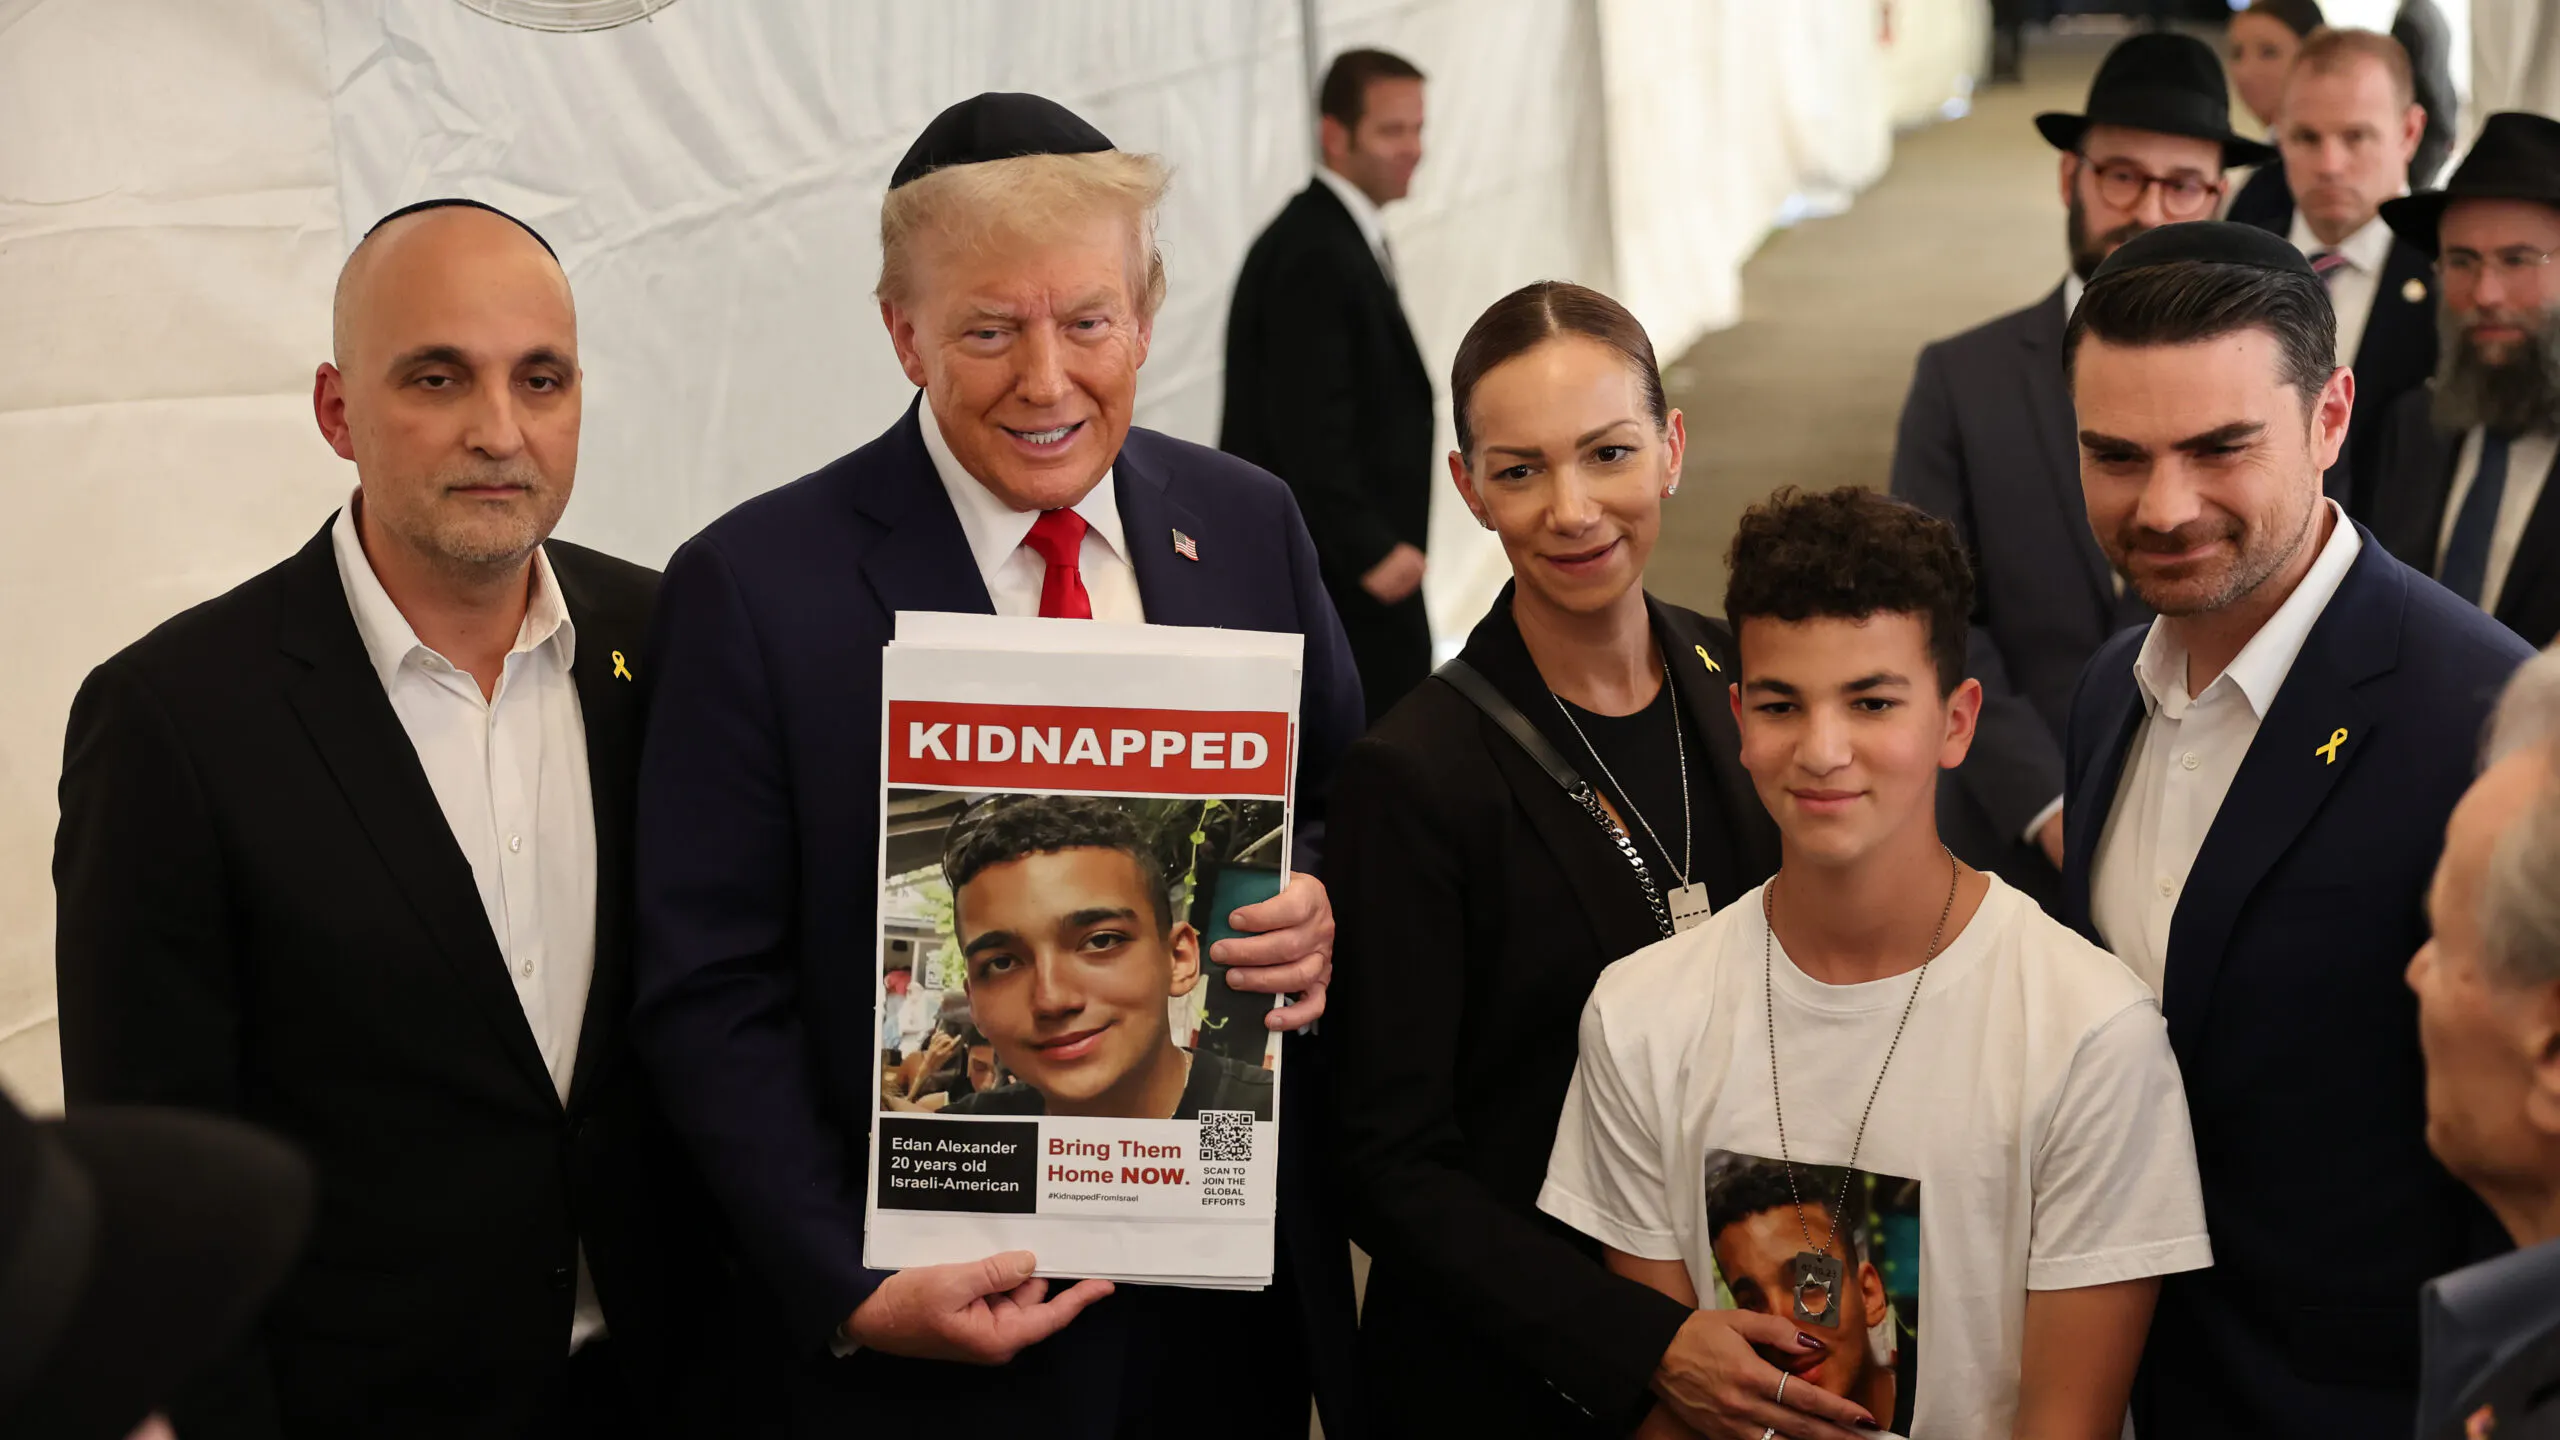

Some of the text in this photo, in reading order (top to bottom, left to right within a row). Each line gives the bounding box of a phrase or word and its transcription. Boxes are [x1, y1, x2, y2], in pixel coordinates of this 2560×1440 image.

[909, 721, 1269, 770] KIDNAPPED
[892, 1137, 1017, 1154] Edan Alexander
[1049, 1138, 1181, 1161] Bring Them
[891, 1156, 987, 1172] 20 years old
[1203, 1167, 1246, 1175] SCAN TO
[891, 1175, 1019, 1191] Israeli-American
[1048, 1165, 1190, 1185] Home NOW.
[1202, 1177, 1246, 1186] JOIN THE
[1048, 1192, 1139, 1202] #KidnappedFromIsrael
[1204, 1187, 1244, 1196] GLOBAL
[1201, 1198, 1246, 1206] EFFORTS
